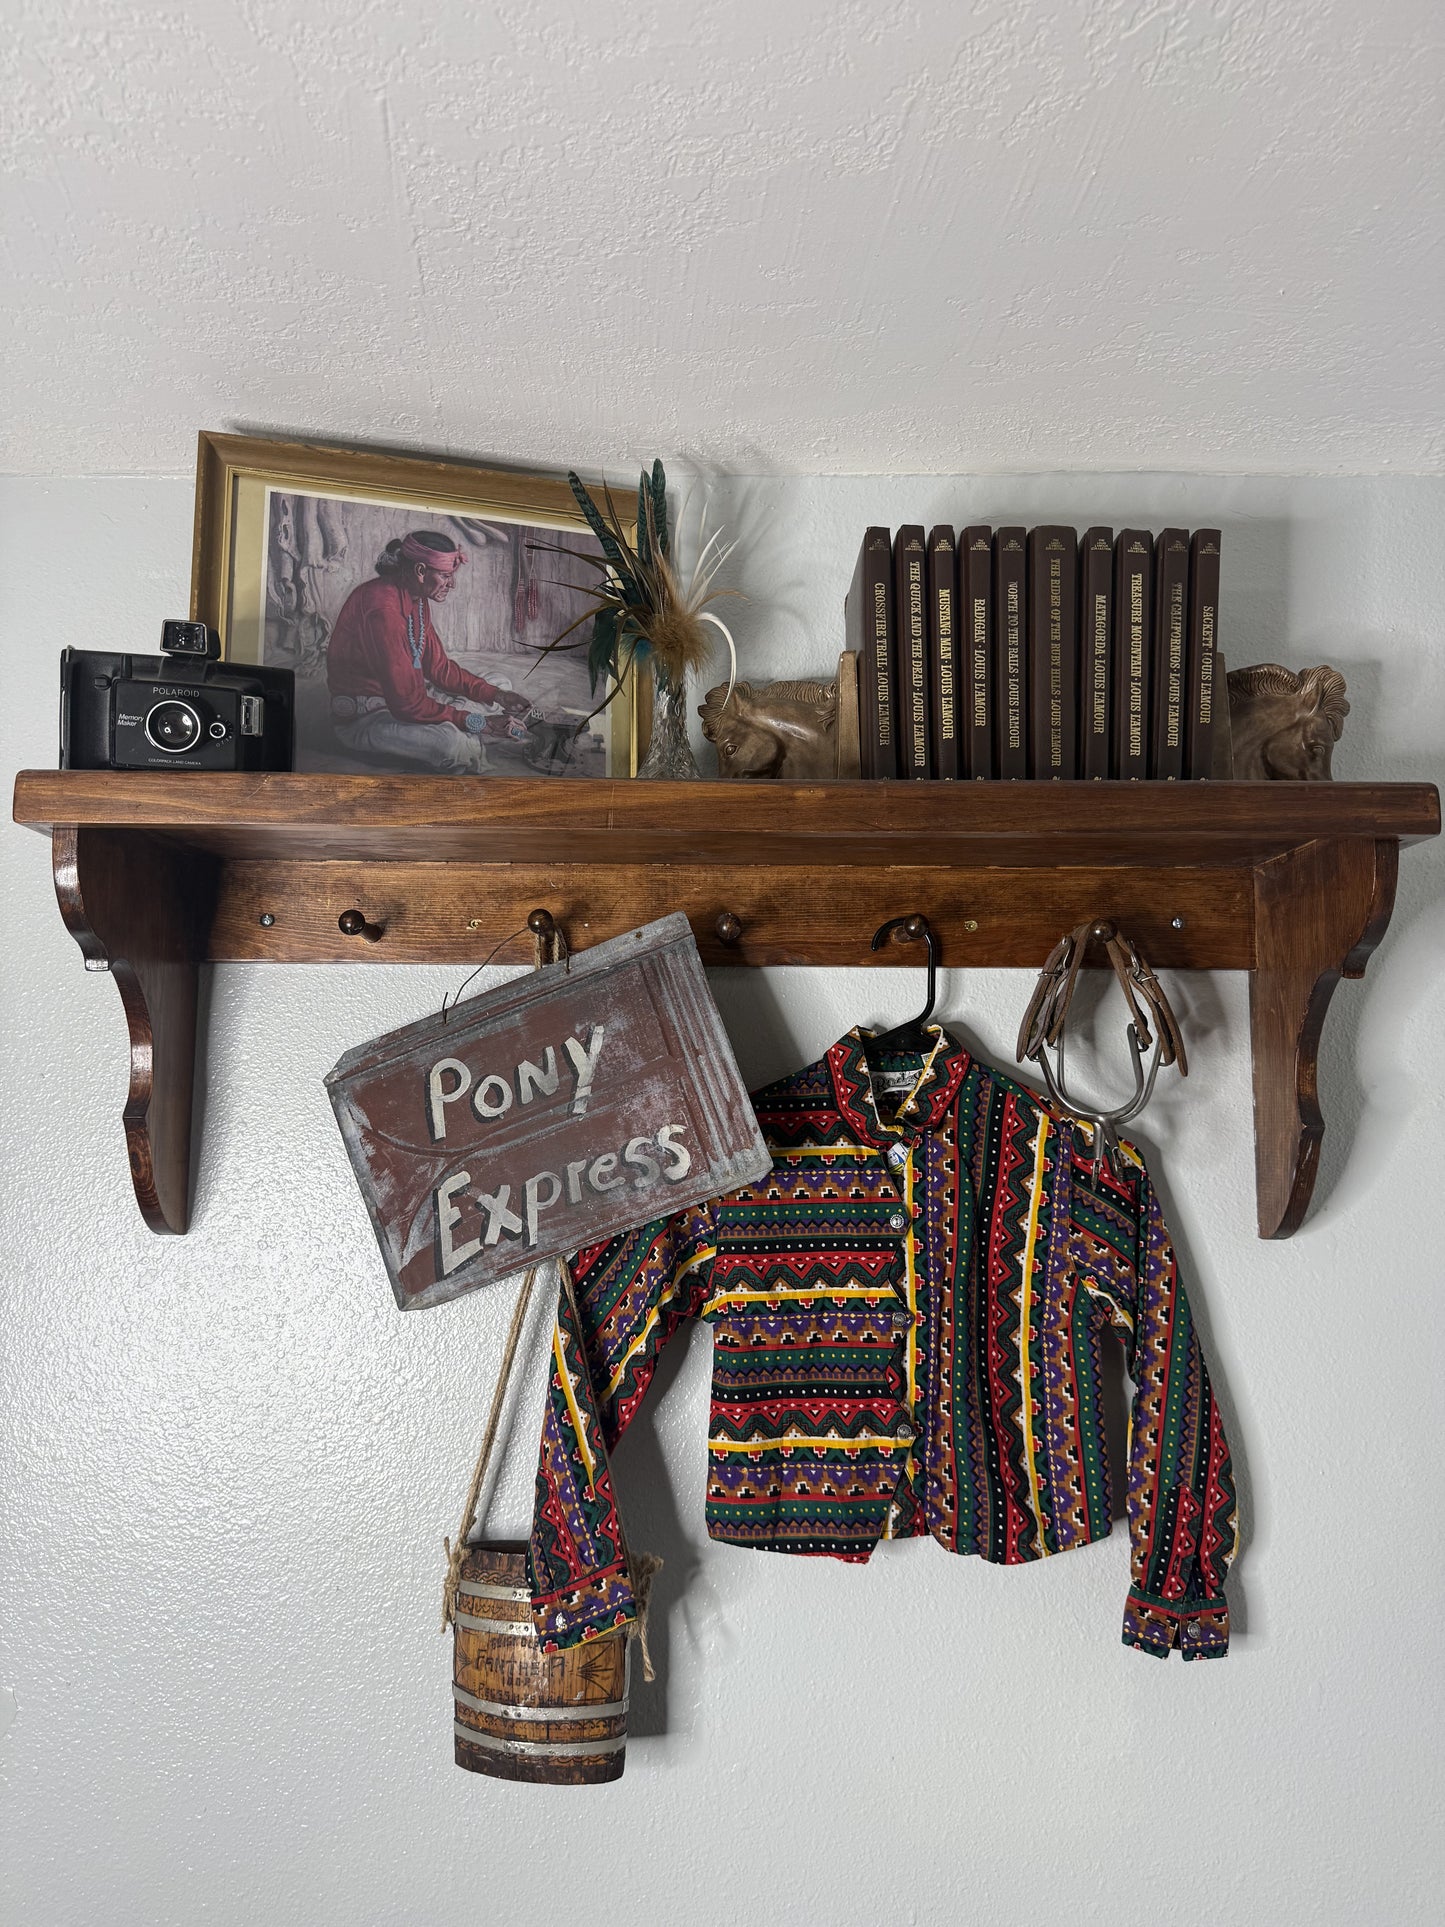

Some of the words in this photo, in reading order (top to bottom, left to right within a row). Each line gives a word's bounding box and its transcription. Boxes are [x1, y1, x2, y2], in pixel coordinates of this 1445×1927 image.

[910, 562, 920, 581] THE
[1051, 559, 1060, 576] THE
[910, 583, 921, 614] QUICK
[1007, 582, 1018, 612] NORTH
[1051, 579, 1060, 606] RIDER
[1132, 574, 1142, 622] TREASURE
[1171, 583, 1182, 604] THE
[875, 583, 886, 636] CROSSFIRE
[939, 589, 950, 635] MUSTANG
[975, 599, 985, 643] RADIGAN
[1051, 609, 1060, 621] OF
[911, 616, 921, 636] AND
[1008, 628, 1018, 649] THE
[1051, 623, 1060, 640] THE
[1095, 595, 1106, 655] MATAGORDA
[1203, 606, 1213, 648] SACKETT
[877, 639, 887, 667] TRAIL
[912, 639, 922, 658] THE
[941, 638, 951, 659] MAN
[1008, 650, 1018, 674] RAILS
[1051, 643, 1060, 669] RUBY
[1131, 626, 1142, 677] MOUNTAIN
[912, 660, 922, 687] DEAD
[975, 650, 985, 679] LOUIS
[1095, 659, 1105, 688] LOUIS
[1202, 653, 1212, 680] LOUIS
[152, 686, 200, 698] POLAROID
[878, 672, 888, 702] LOUIS
[941, 665, 952, 694] LOUIS
[1009, 679, 1019, 706] LOUIS
[1169, 673, 1180, 702] LOUIS
[913, 692, 923, 721] LOUIS
[975, 683, 985, 726] L'AMOUR
[1131, 682, 1141, 711] LOUIS
[1200, 683, 1211, 723] L'AMOUR
[119, 713, 144, 722] Memory
[879, 704, 890, 746] L'AMOUR
[942, 697, 953, 739] L'AMOUR
[1051, 700, 1061, 725] LOUIS
[1094, 692, 1105, 733] L'AMOUR
[1168, 705, 1179, 746] L'AMOUR
[1009, 709, 1019, 747] L'AMOUR
[1130, 714, 1141, 755] L'AMOUR
[914, 725, 925, 766] L'AMOUR
[1052, 729, 1061, 766] L'AMOUR
[436, 1124, 692, 1276] Express
